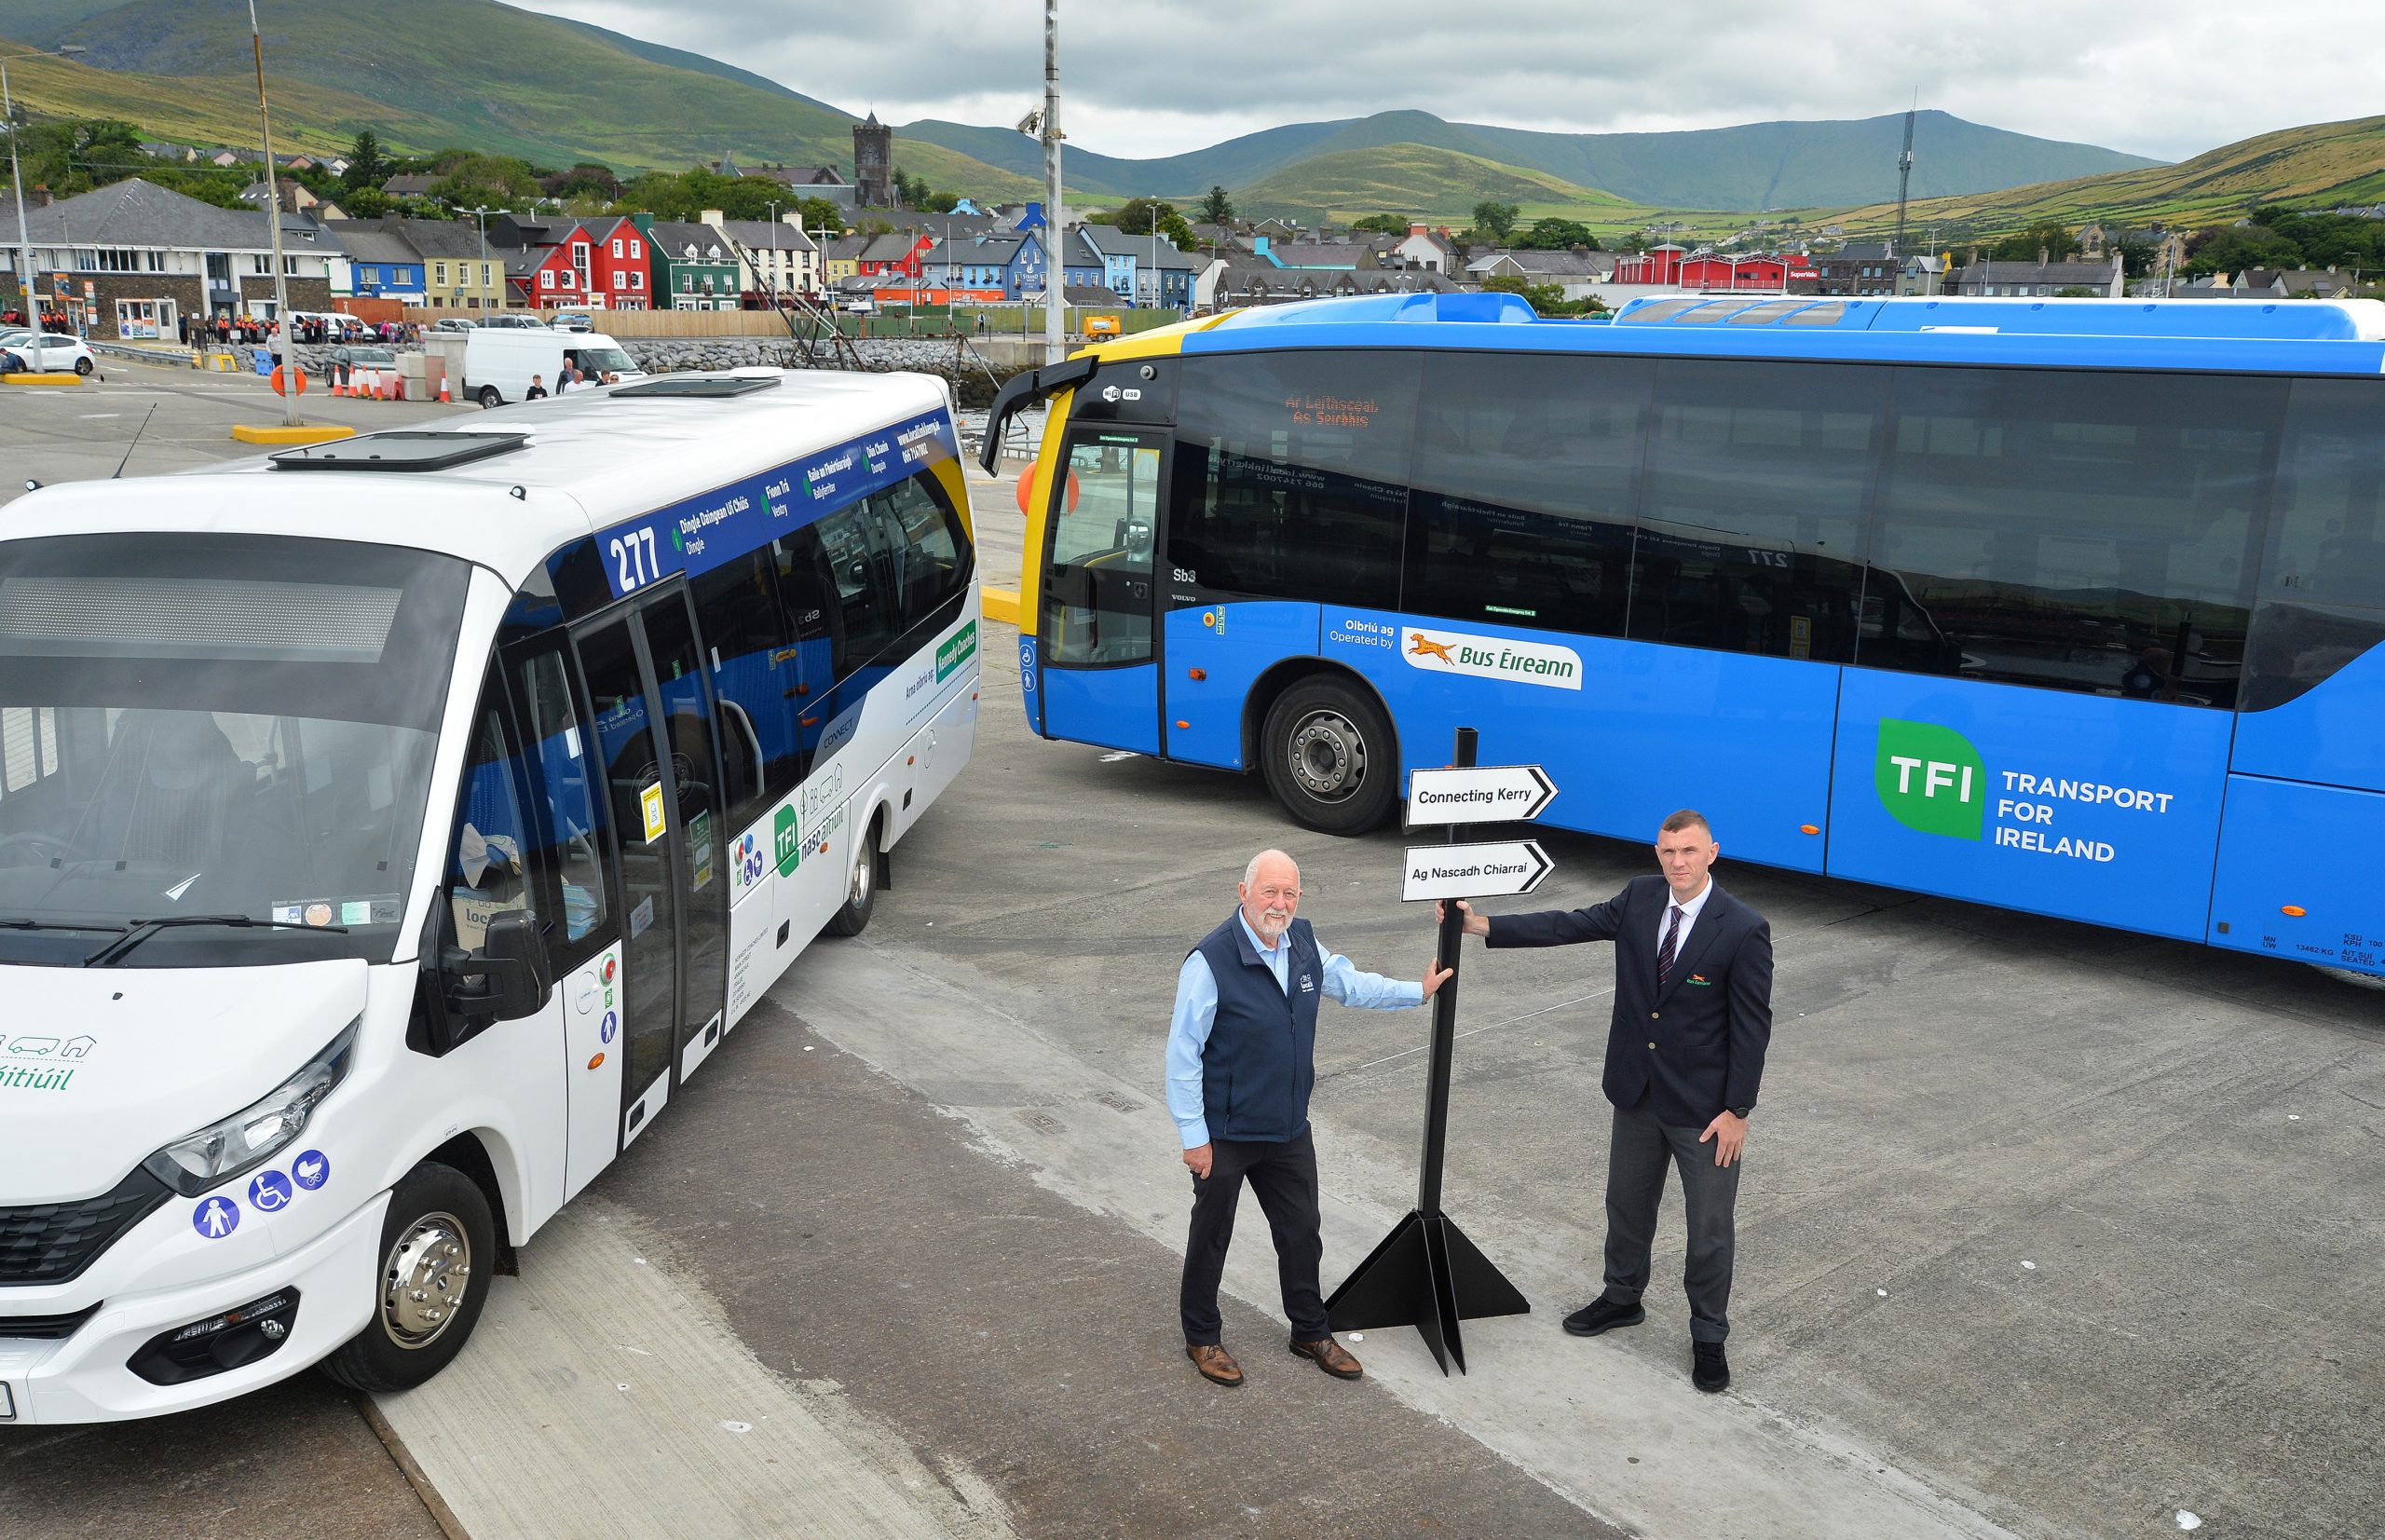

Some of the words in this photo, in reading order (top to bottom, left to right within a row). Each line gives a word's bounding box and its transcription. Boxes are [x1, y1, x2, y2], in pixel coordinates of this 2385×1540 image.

[1790, 270, 1817, 279] SuperValu
[771, 503, 788, 518] Ventry
[679, 514, 701, 535] Dingle
[699, 509, 729, 527] Daingean
[686, 537, 705, 555] Dingle
[610, 525, 660, 593] 277
[1173, 568, 1196, 583] Sb3
[1345, 620, 1378, 634] Oibriú
[1381, 626, 1395, 637] ag
[1330, 630, 1378, 647] Operated
[1381, 636, 1394, 649] by
[937, 643, 958, 674] Kennedy
[957, 632, 975, 656] Coaches
[1459, 647, 1495, 667] Bus
[1889, 755, 1973, 803] TFI
[1418, 789, 1493, 804] Connecting
[1497, 788, 1532, 801] Kerry
[2003, 770, 2174, 814] TRANSPORT
[1997, 798, 2053, 825] FOR
[777, 822, 796, 859] TFI
[801, 829, 821, 863] nasc
[1994, 826, 2115, 863] IRELAND
[1412, 868, 1427, 881] Ag
[1431, 865, 1480, 878] Nascadh
[1483, 863, 1528, 876] Chiarraí
[466, 907, 491, 924] loc
[2262, 941, 2277, 949] UW
[2342, 939, 2362, 948] KPH
[2368, 939, 2383, 948] 100
[2344, 933, 2363, 942] KSU
[2296, 944, 2320, 954] 13462
[2340, 956, 2376, 967] SEATED
